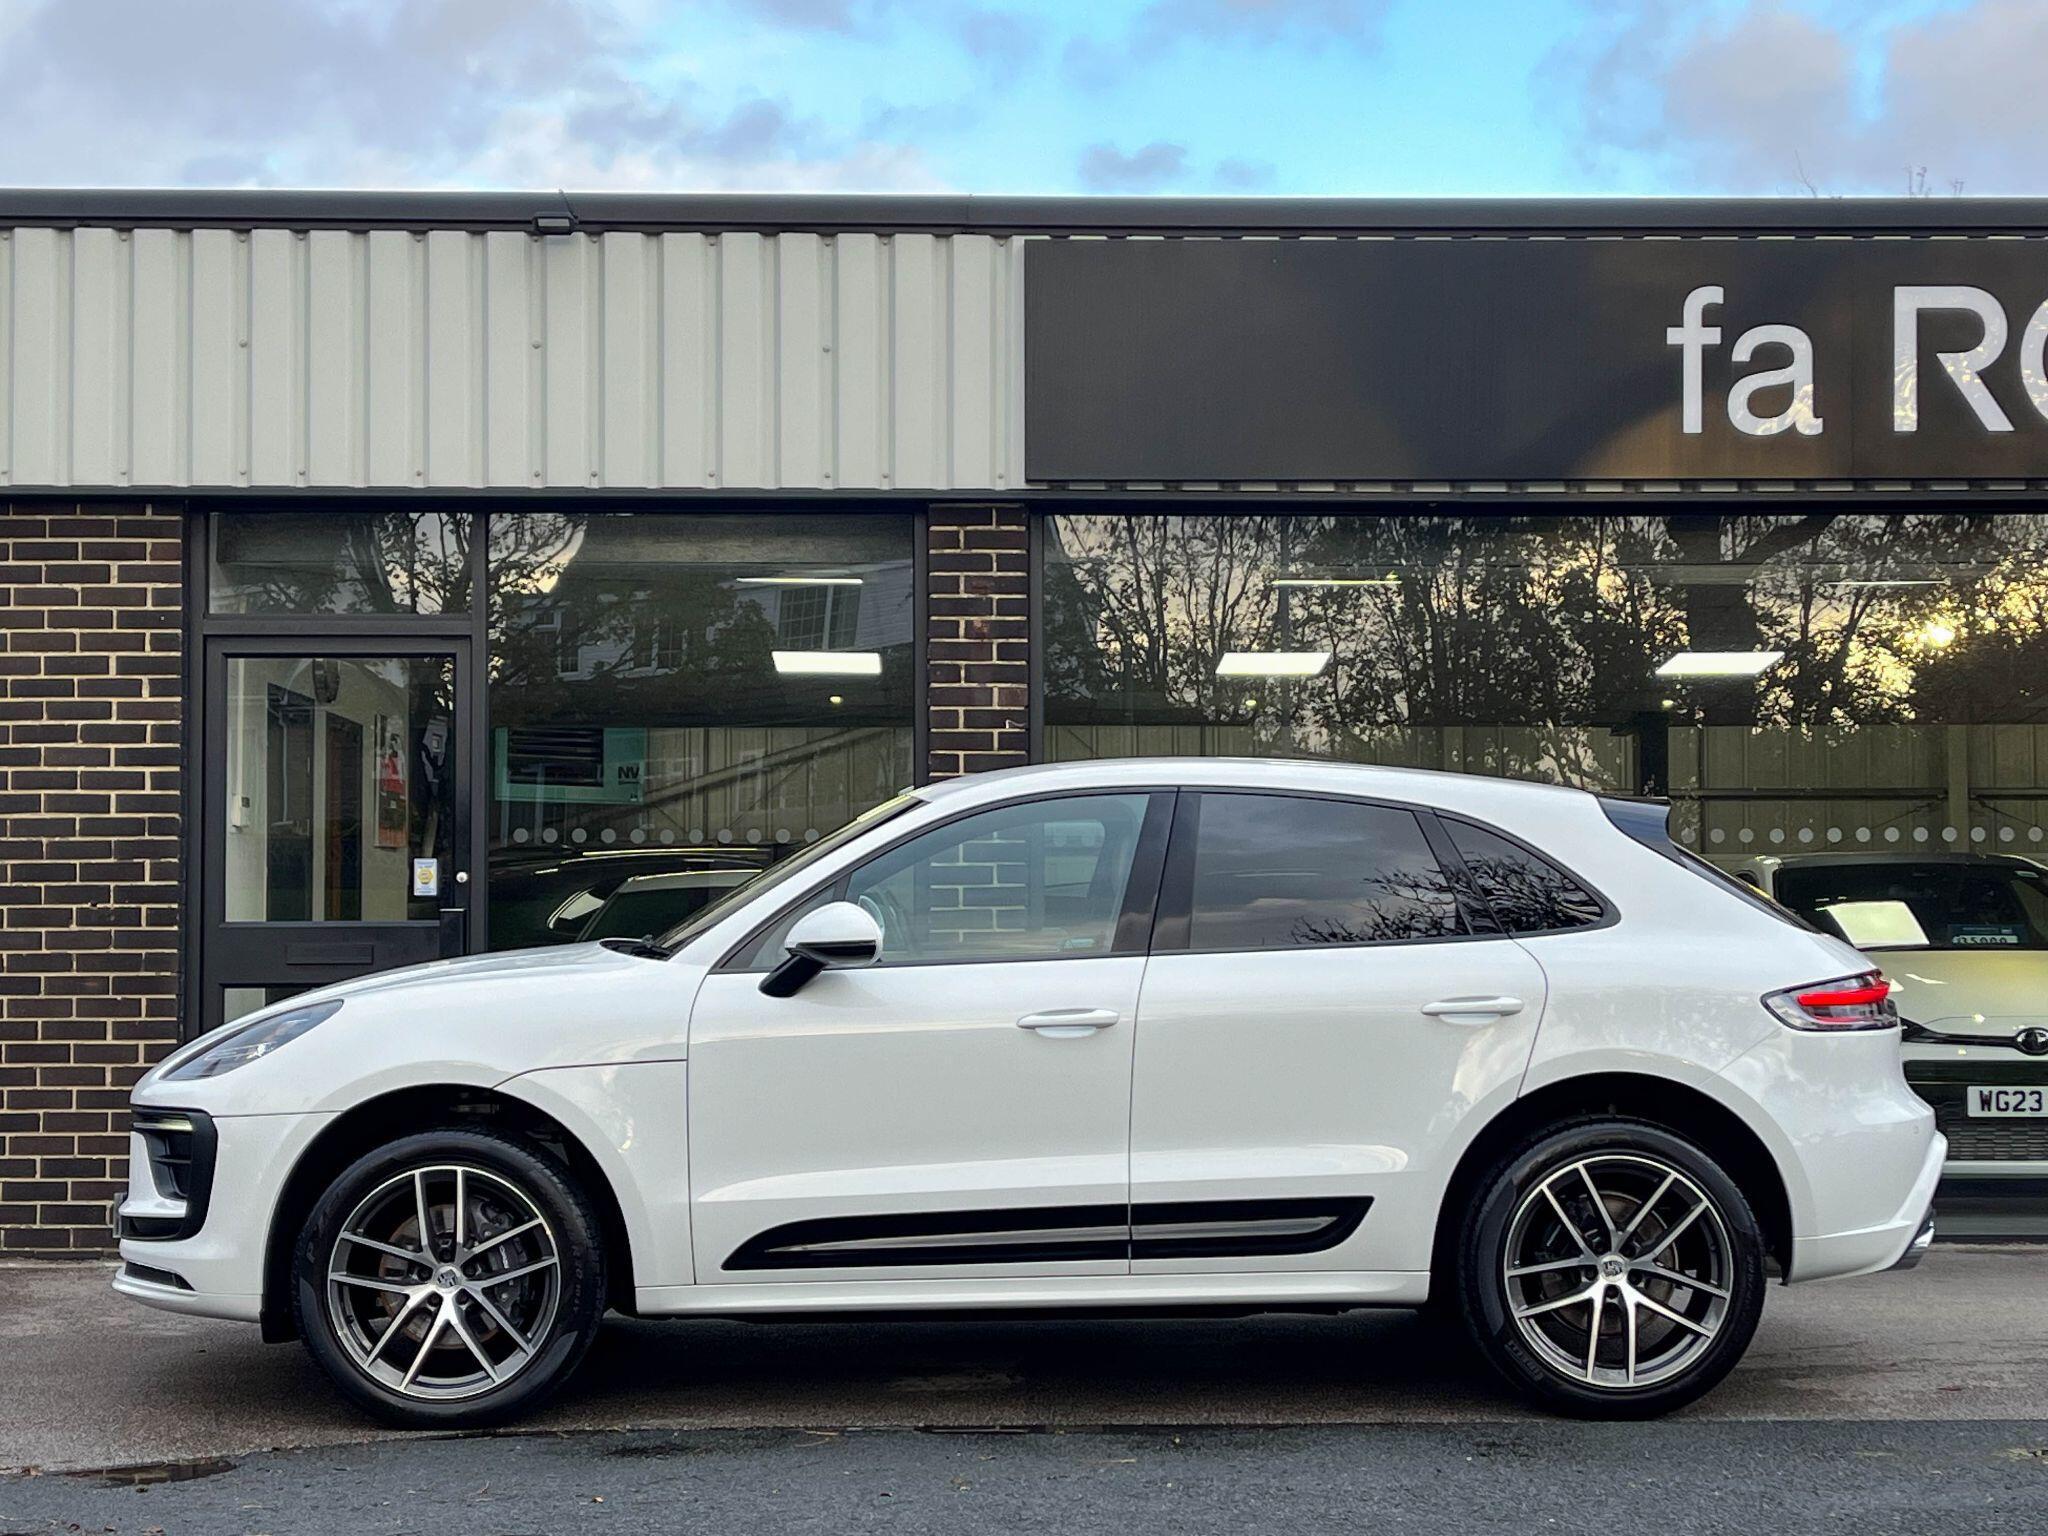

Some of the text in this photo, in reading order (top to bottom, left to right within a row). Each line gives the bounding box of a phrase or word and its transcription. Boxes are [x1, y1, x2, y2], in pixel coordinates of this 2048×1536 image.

[1666, 285, 2048, 435] fa R
[1979, 1090, 2043, 1112] WG23
